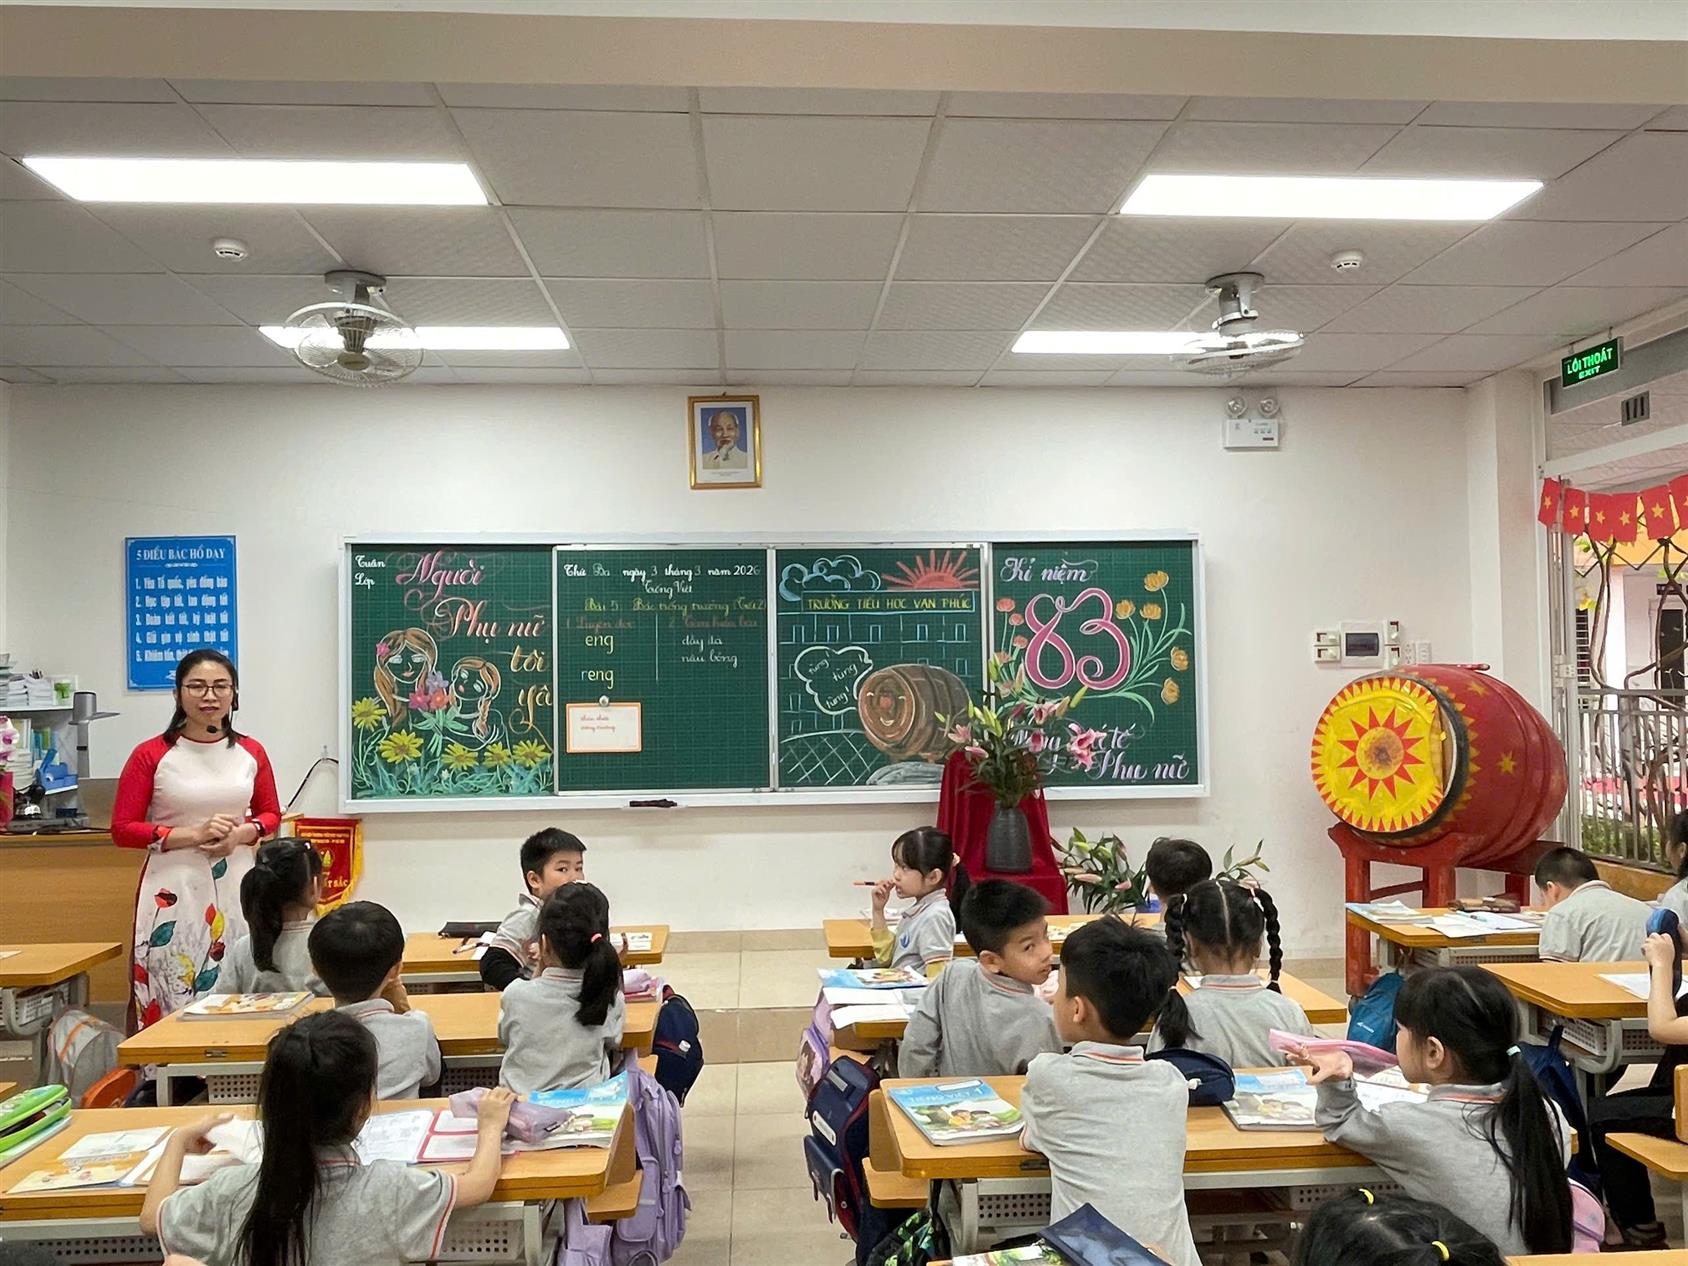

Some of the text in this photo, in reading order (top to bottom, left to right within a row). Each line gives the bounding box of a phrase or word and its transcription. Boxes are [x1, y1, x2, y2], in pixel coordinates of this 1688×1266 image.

[1567, 347, 1613, 374] LỐI THOÁT
[1578, 365, 1601, 379] EXIT
[136, 550, 142, 561] 5
[396, 549, 485, 602] Người
[622, 568, 647, 582] ngày
[651, 565, 658, 576] 3
[664, 563, 693, 581] tháng
[694, 564, 701, 576] 3
[1041, 563, 1090, 585] niệm
[434, 596, 545, 644] Phụ nữ
[585, 635, 614, 655] eng
[581, 669, 614, 690] reng
[1152, 754, 1190, 780] nữ
